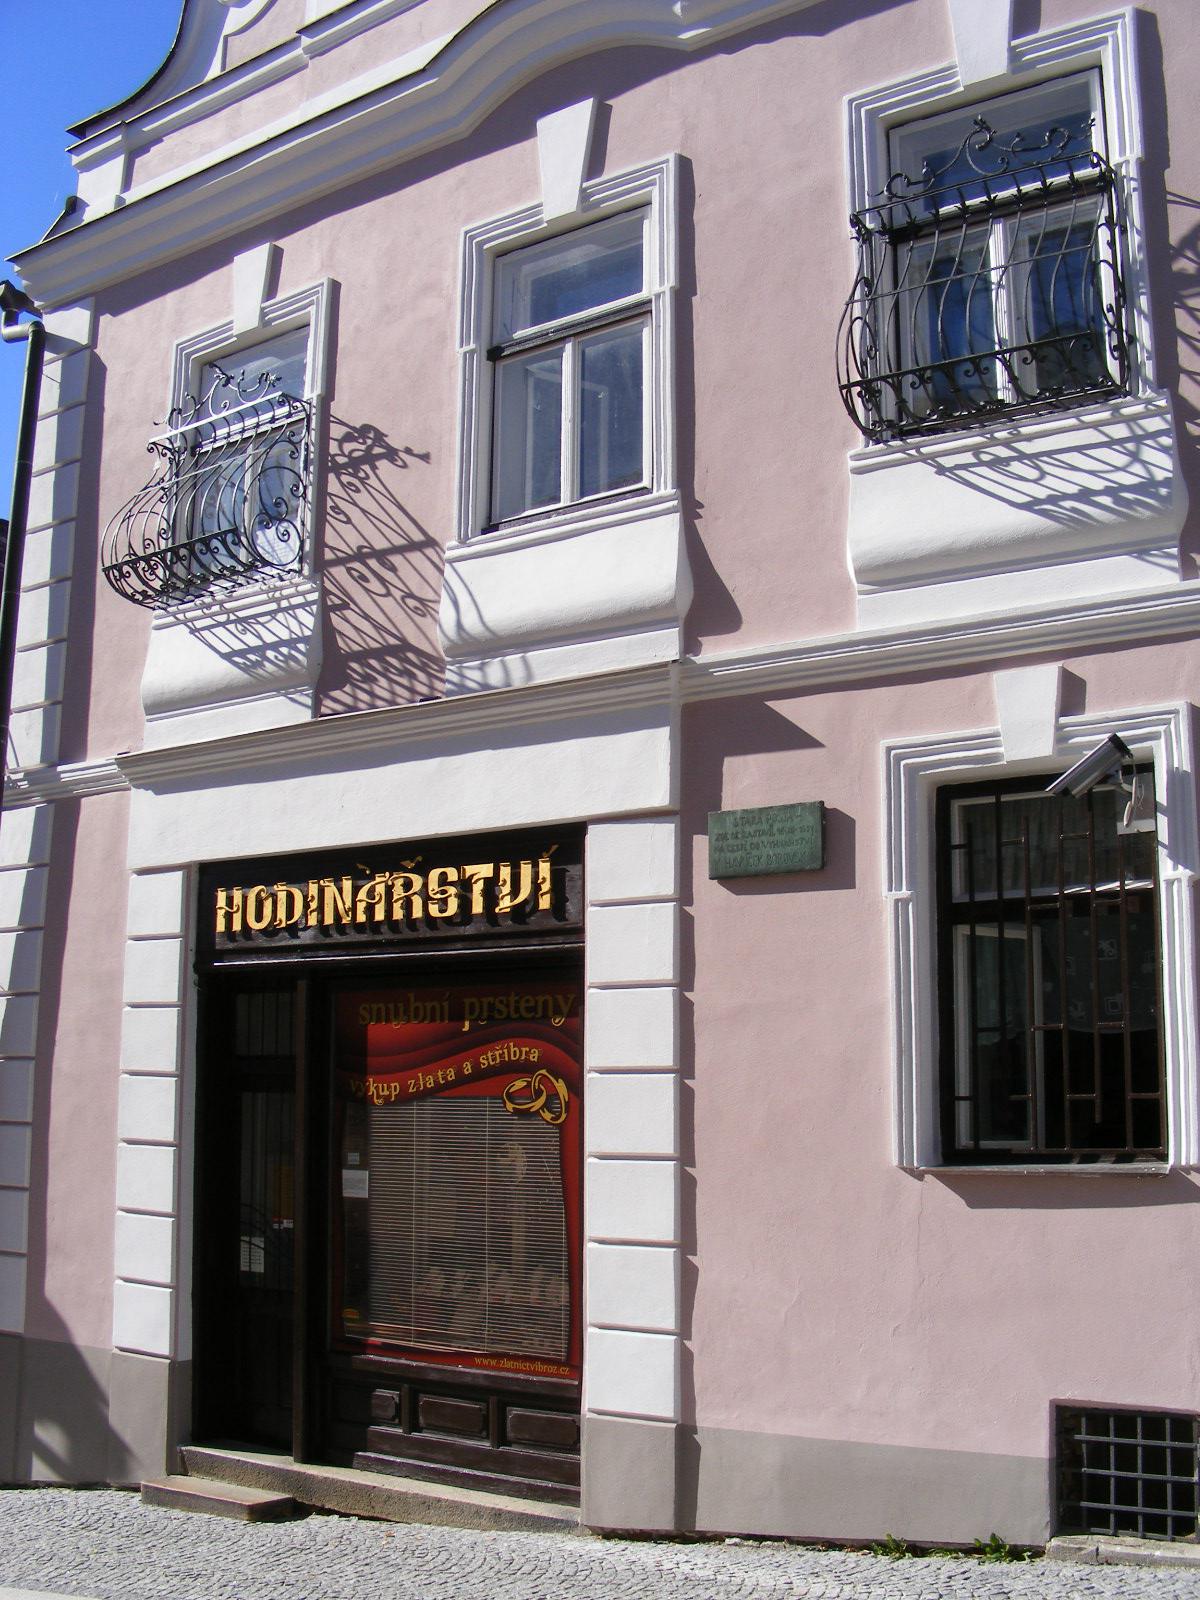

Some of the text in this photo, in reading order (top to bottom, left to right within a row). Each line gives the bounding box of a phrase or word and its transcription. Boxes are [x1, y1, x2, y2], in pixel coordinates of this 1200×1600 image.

[215, 844, 560, 933] HODINÁŘSTVÍ
[359, 991, 576, 1032] snubní prsteny
[408, 1066, 456, 1093] zlata
[463, 1061, 472, 1076] a
[480, 1042, 540, 1068] stříbra
